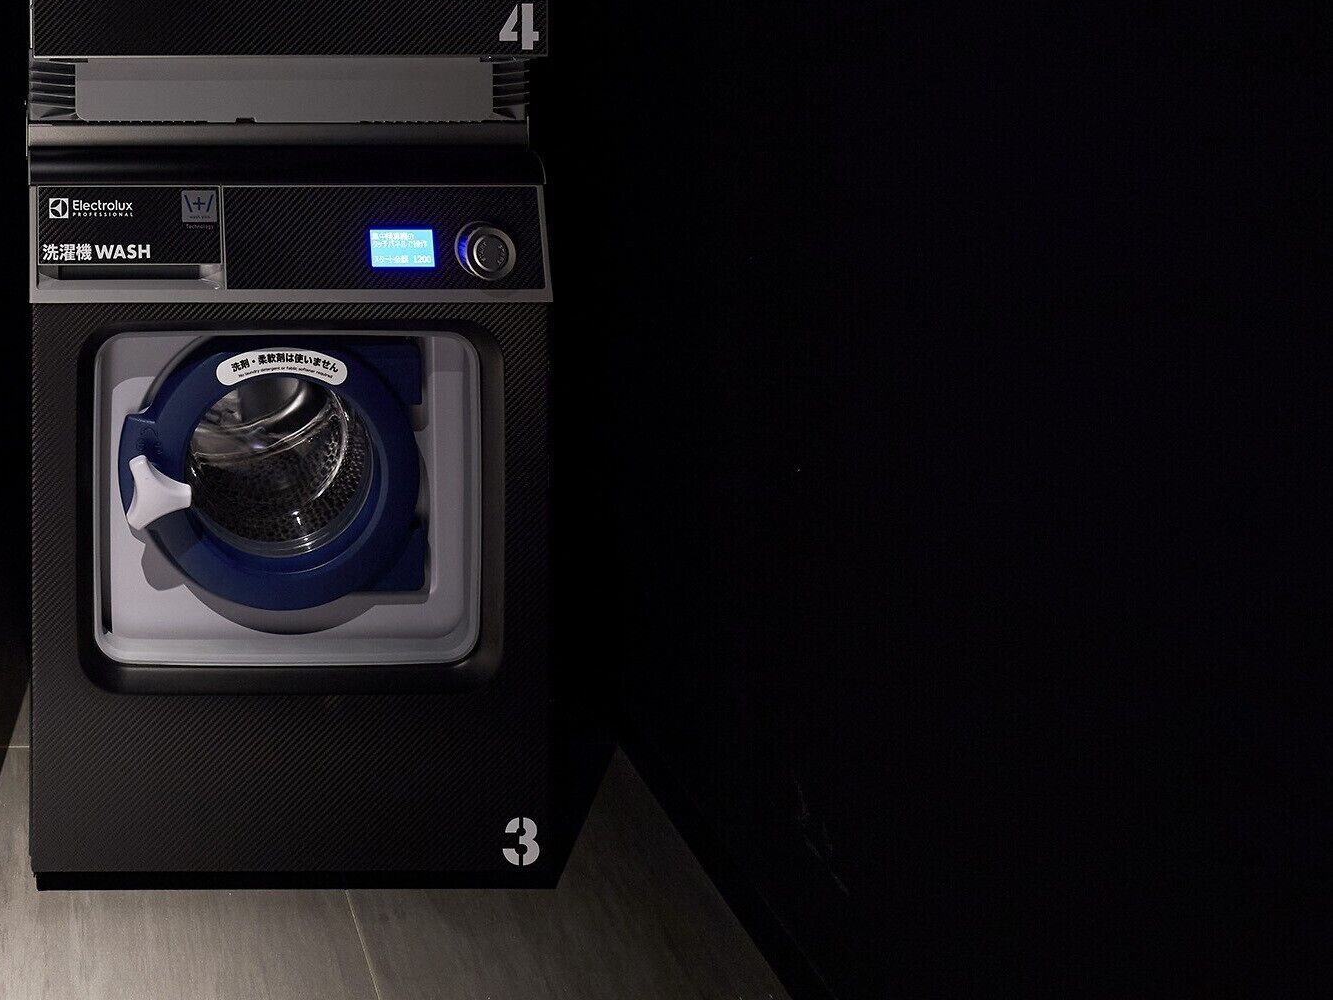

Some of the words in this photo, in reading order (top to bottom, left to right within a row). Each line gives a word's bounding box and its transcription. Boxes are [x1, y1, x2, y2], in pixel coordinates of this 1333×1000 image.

[499, 3, 539, 50] 4
[72, 200, 133, 211] Electrolux
[42, 243, 92, 261] 洗濯機
[94, 244, 151, 259] WASH
[502, 817, 540, 866] 3
